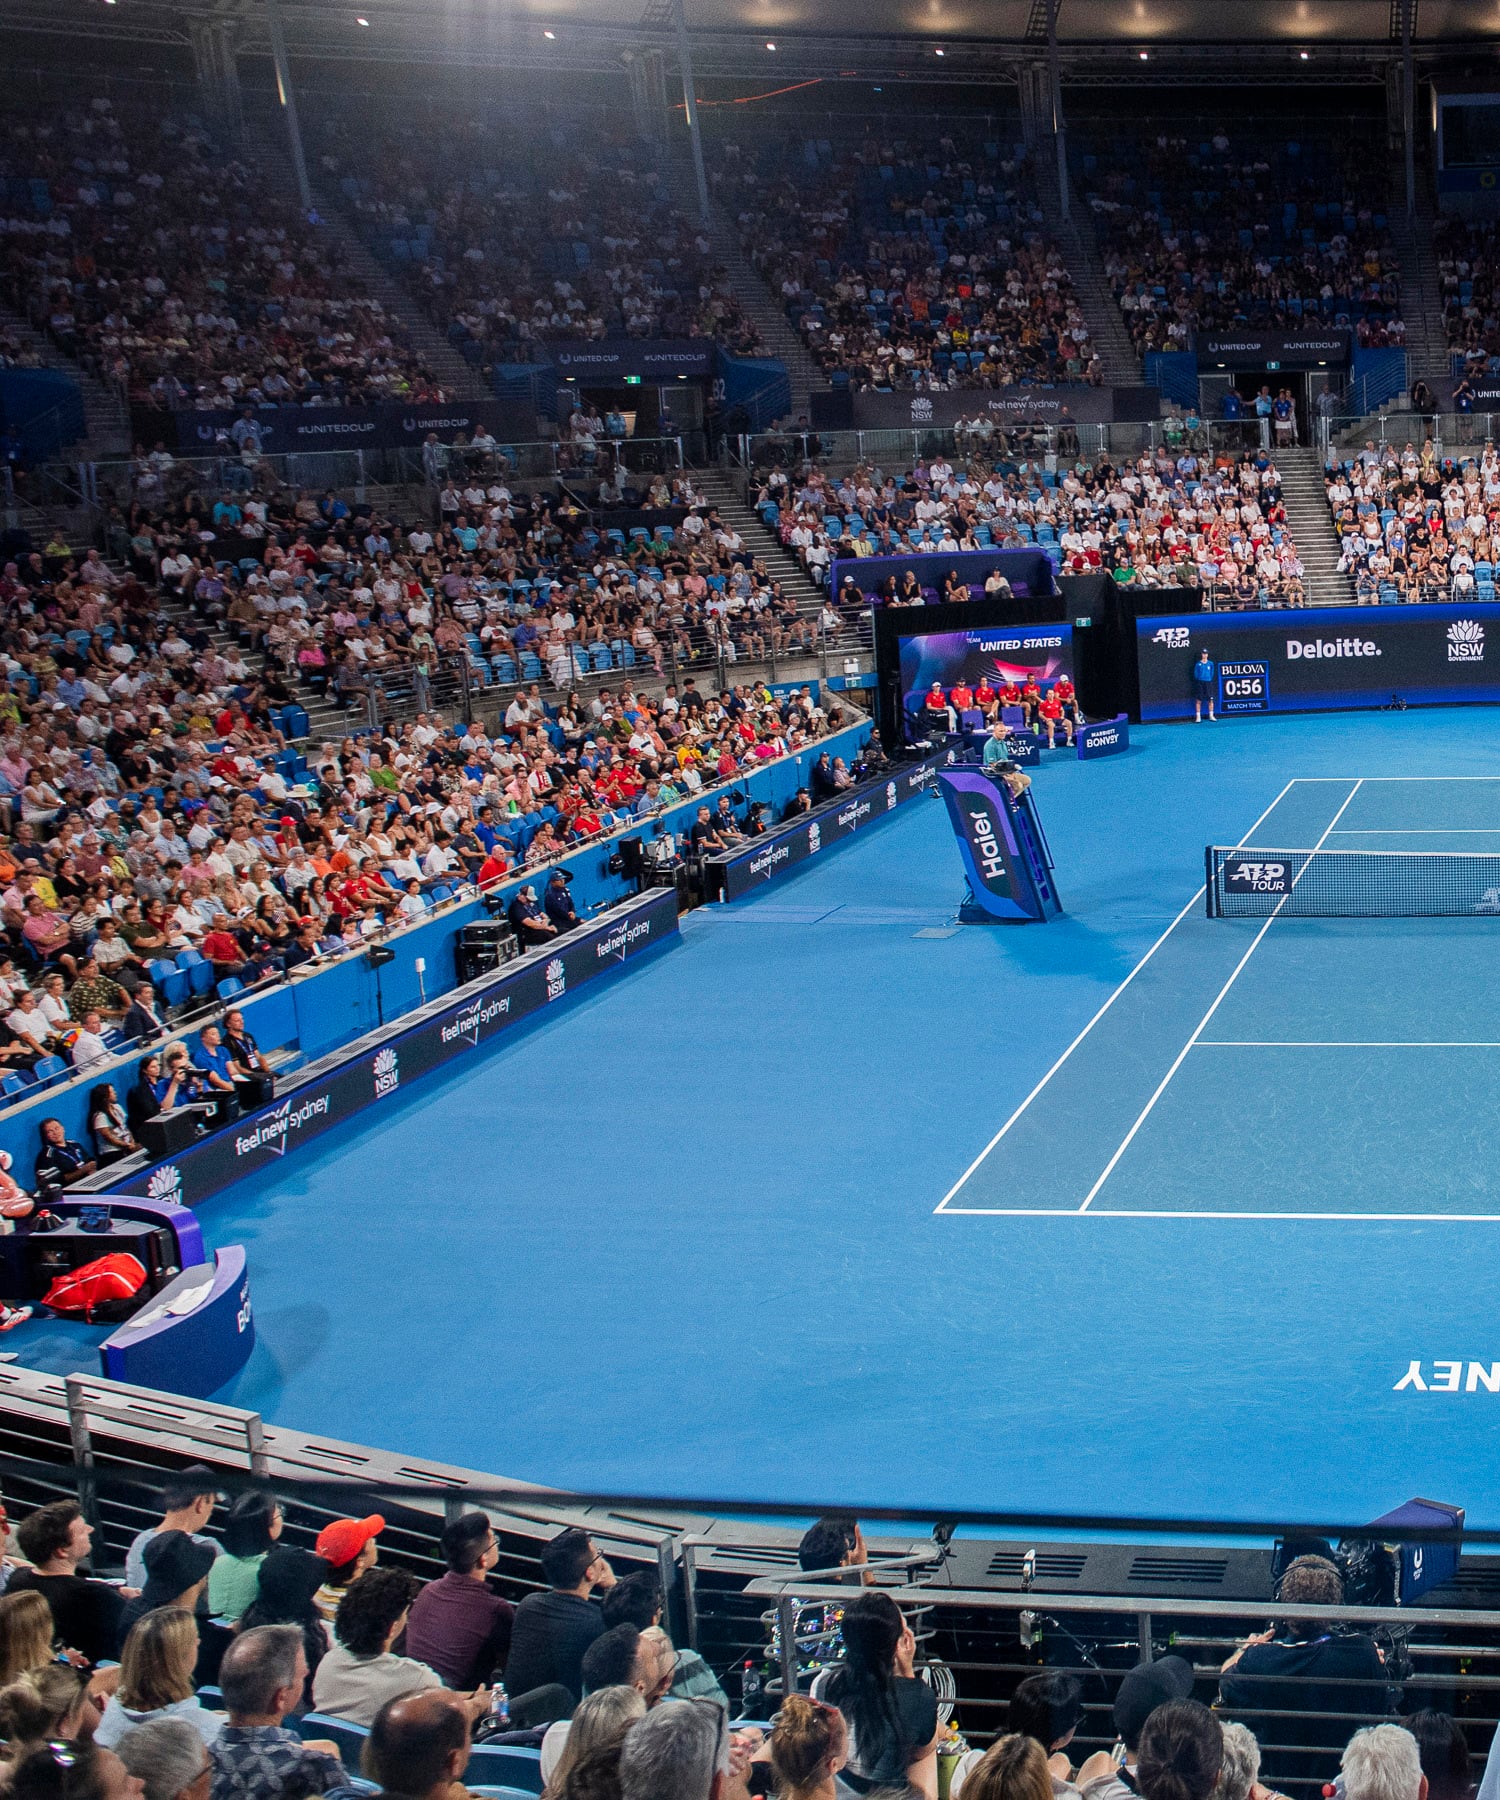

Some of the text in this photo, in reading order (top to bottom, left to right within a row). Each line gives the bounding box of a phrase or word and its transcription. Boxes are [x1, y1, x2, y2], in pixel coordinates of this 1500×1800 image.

[1219, 343, 1246, 351] UNITED
[1283, 341, 1341, 350] #UNITEDCUP
[573, 354, 620, 363] UNITED CUP
[988, 400, 1060, 411] feel new sydney
[911, 411, 932, 420] NSW
[417, 418, 470, 429] UNITED CUP
[1151, 627, 1190, 643] ATP
[980, 637, 1062, 652] UNITED STATES
[1167, 639, 1190, 648] TOUR
[1286, 638, 1382, 660] Deloitte.
[1447, 642, 1484, 656] NSW
[1221, 664, 1265, 675] BULOVA
[1225, 678, 1262, 696] 0:56
[1086, 733, 1120, 748] BONVOY
[969, 812, 1006, 879] Haier
[1229, 863, 1285, 881] ATP
[1251, 880, 1285, 891] TOUR
[597, 920, 650, 957] feel new sydney
[547, 976, 566, 997] NSW
[441, 996, 510, 1043] feel new sydney
[375, 1068, 399, 1094] NSW
[235, 1094, 330, 1156] feel new sydney
